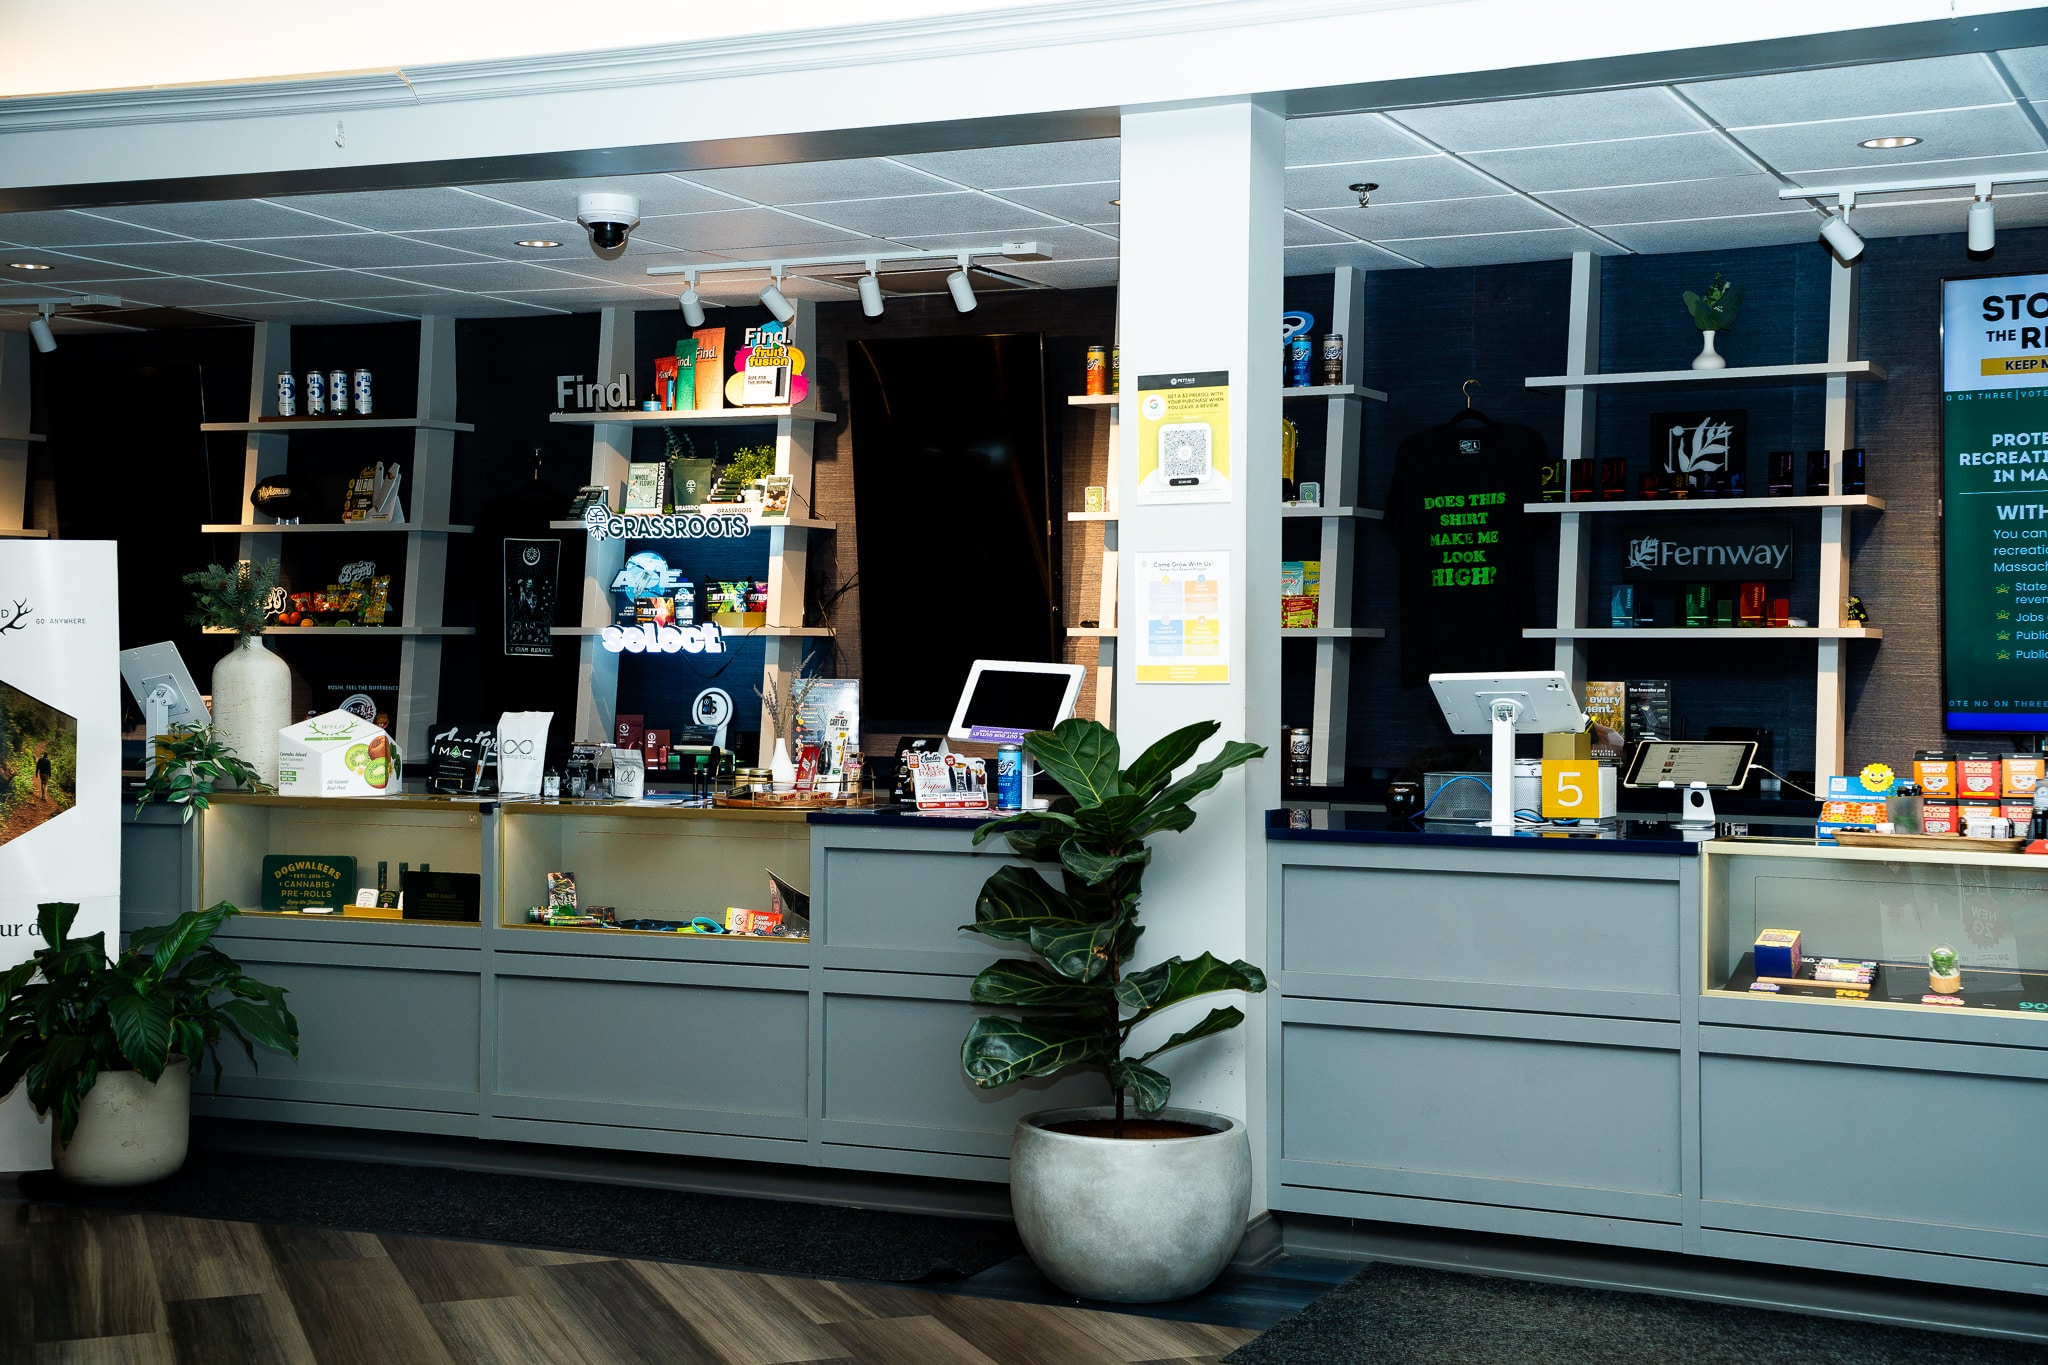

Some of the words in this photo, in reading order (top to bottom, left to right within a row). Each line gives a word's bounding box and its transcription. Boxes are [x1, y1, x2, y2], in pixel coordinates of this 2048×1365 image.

[1982, 292, 2048, 322] STO
[744, 327, 792, 345] Find.
[1986, 329, 2017, 342] THE
[754, 346, 785, 357] fruit
[749, 356, 789, 367] fusion
[2005, 359, 2039, 370] KEEP
[556, 373, 636, 409] Find.
[1978, 392, 2013, 400] THREE
[2020, 390, 2048, 398] VOTE
[1992, 431, 2048, 447] PROTE
[1959, 450, 2048, 466] RECREATI
[1993, 469, 2015, 483] IN
[2021, 468, 2048, 482] MA
[1424, 495, 1466, 510] DOES
[1468, 492, 1506, 506] THIS
[1440, 512, 1489, 526] SHIRT
[1996, 504, 2048, 520] WITH
[606, 515, 747, 538] GRASSROOTS
[1430, 532, 1474, 546] MAKE
[1477, 530, 1499, 544] ME
[1994, 529, 2018, 539] You
[2021, 530, 2048, 539] can
[1442, 550, 1487, 564] LOOK
[1661, 541, 1790, 569] Fernway
[1431, 566, 1497, 586] HIGH?
[2015, 582, 2048, 592] State
[2015, 596, 2048, 604] reven
[2015, 612, 2044, 622] Jobs
[1590, 696, 1620, 706] every
[1557, 772, 1583, 807] 5
[274, 861, 342, 880] DOGWALKERS
[284, 880, 330, 888] CANNABIS
[282, 890, 332, 898] PRE-ROLLS
